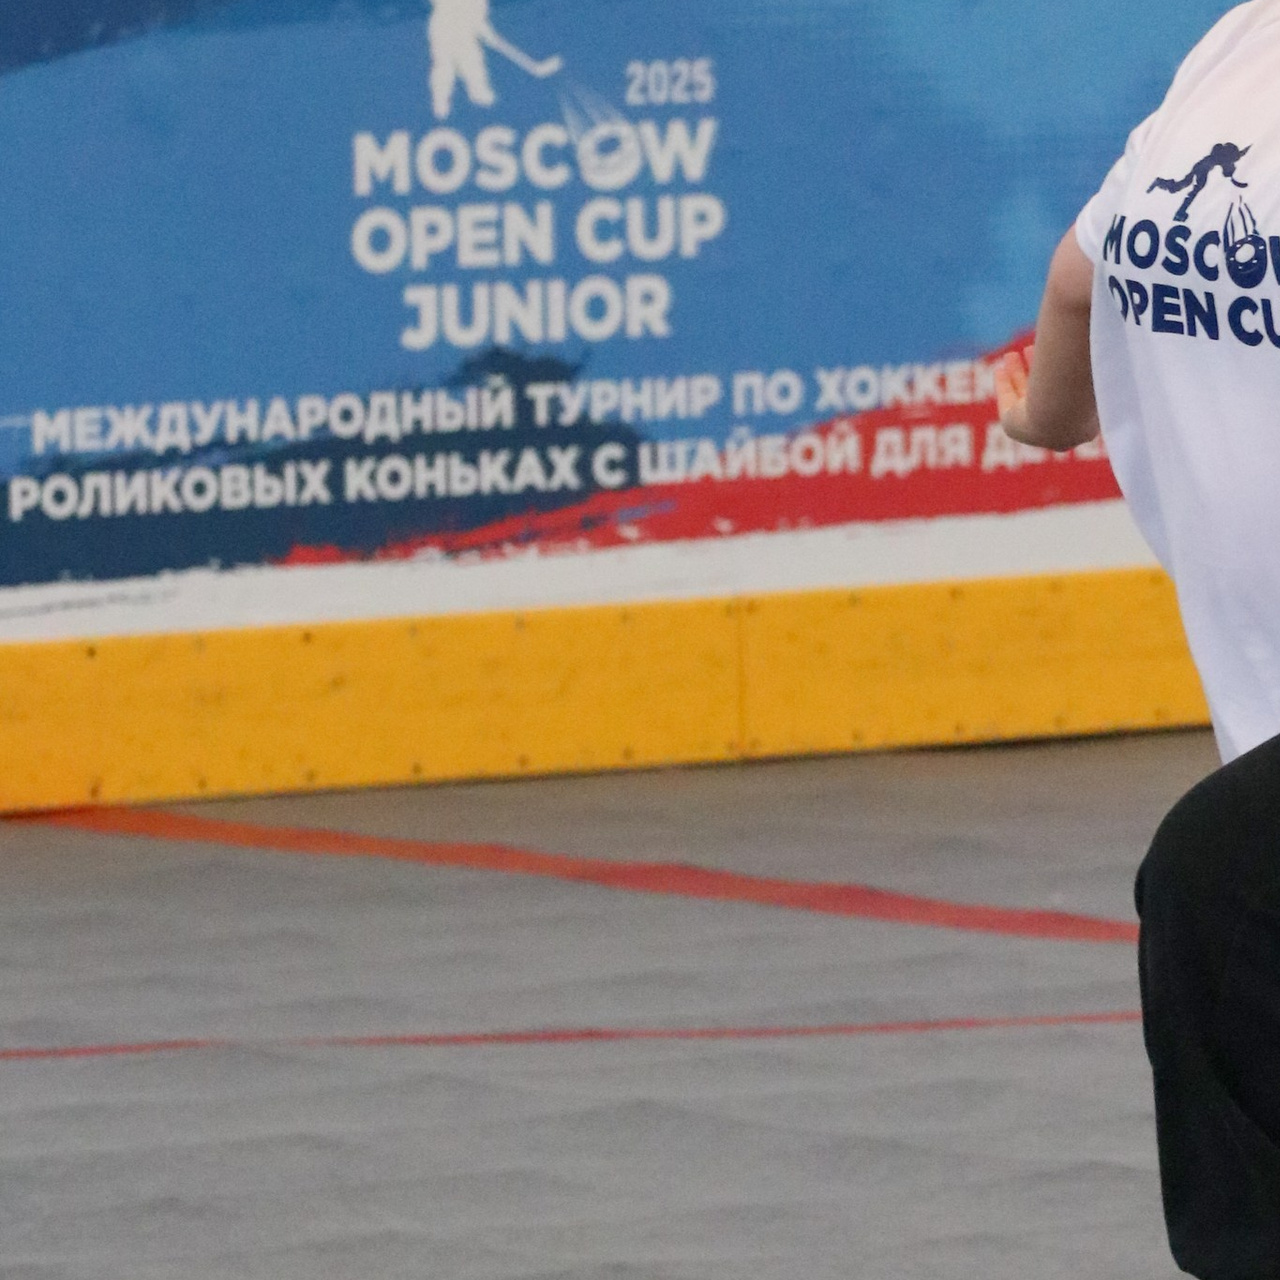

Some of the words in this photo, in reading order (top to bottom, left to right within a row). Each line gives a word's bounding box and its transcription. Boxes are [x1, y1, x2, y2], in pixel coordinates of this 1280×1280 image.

[625, 57, 716, 106] 2025
[352, 117, 719, 197] MOSCOW
[351, 199, 555, 274] OPEN
[575, 192, 726, 263] CUP
[401, 273, 673, 350] JUNIOR
[32, 372, 515, 455] МЕЖДУНАРОДНЫЙ
[525, 374, 722, 428] ТУРНИР
[733, 368, 804, 416] ПО
[8, 458, 332, 521] РОЛИКОВЫХ
[344, 443, 581, 504] КОНЬКАХ
[592, 441, 627, 489] С
[638, 418, 861, 485] ШАЙБОЙ
[870, 422, 974, 480] ДЛЯ
